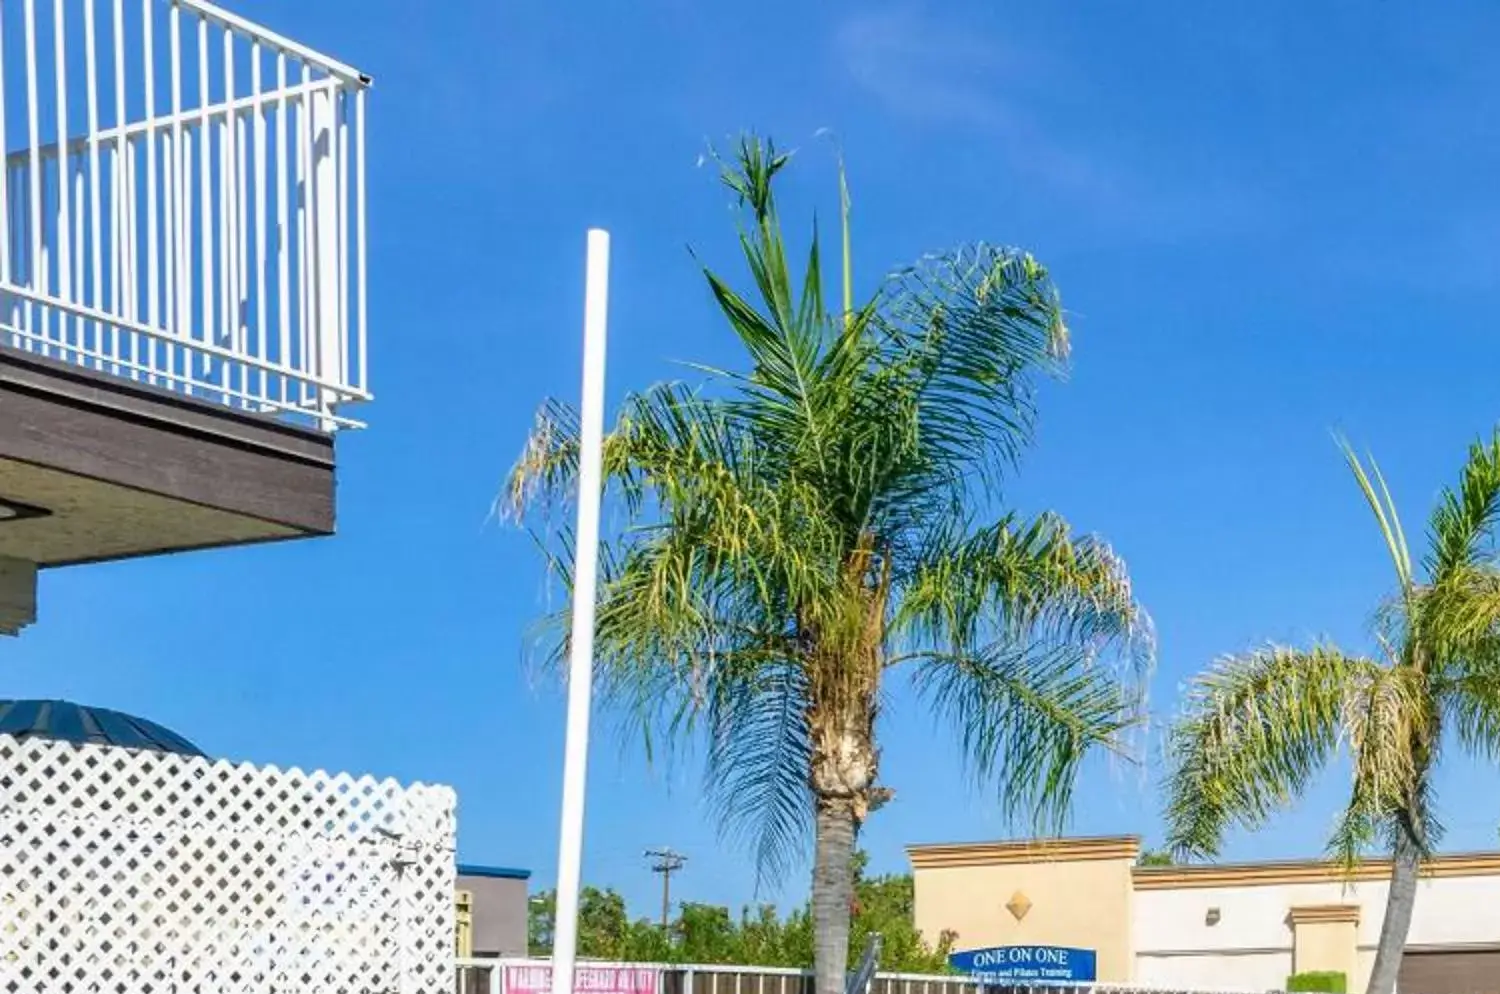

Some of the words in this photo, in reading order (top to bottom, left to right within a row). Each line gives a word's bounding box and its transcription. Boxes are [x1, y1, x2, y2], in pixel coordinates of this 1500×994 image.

[973, 951, 1006, 967] ONE
[1009, 948, 1031, 962] ON
[1036, 948, 1068, 965] ONE
